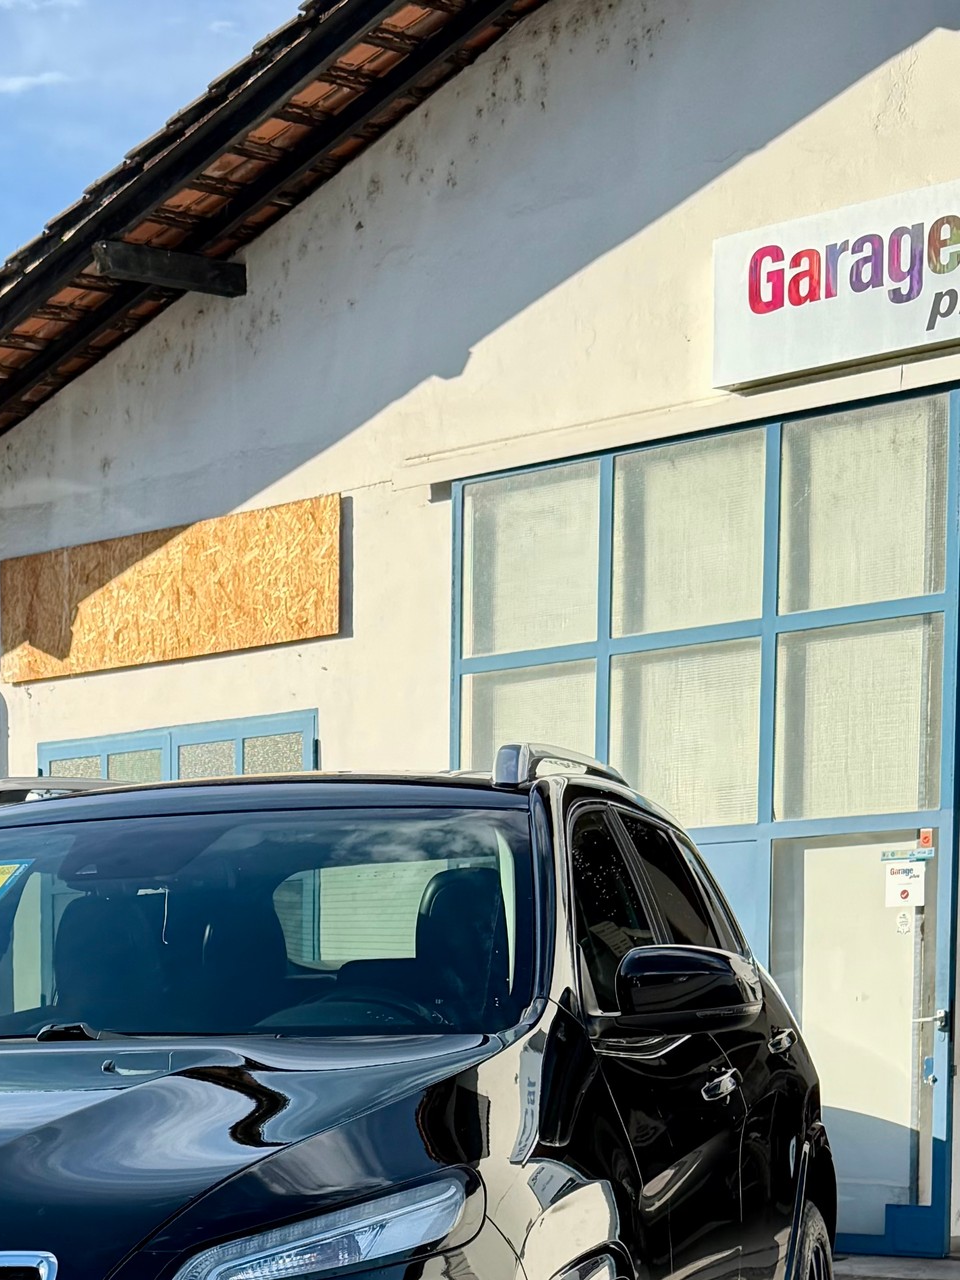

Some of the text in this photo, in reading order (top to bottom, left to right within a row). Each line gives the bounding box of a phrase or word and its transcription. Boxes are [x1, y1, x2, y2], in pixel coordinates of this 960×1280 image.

[748, 214, 960, 315] Garage
[925, 288, 960, 331] p
[890, 867, 914, 877] Garage
